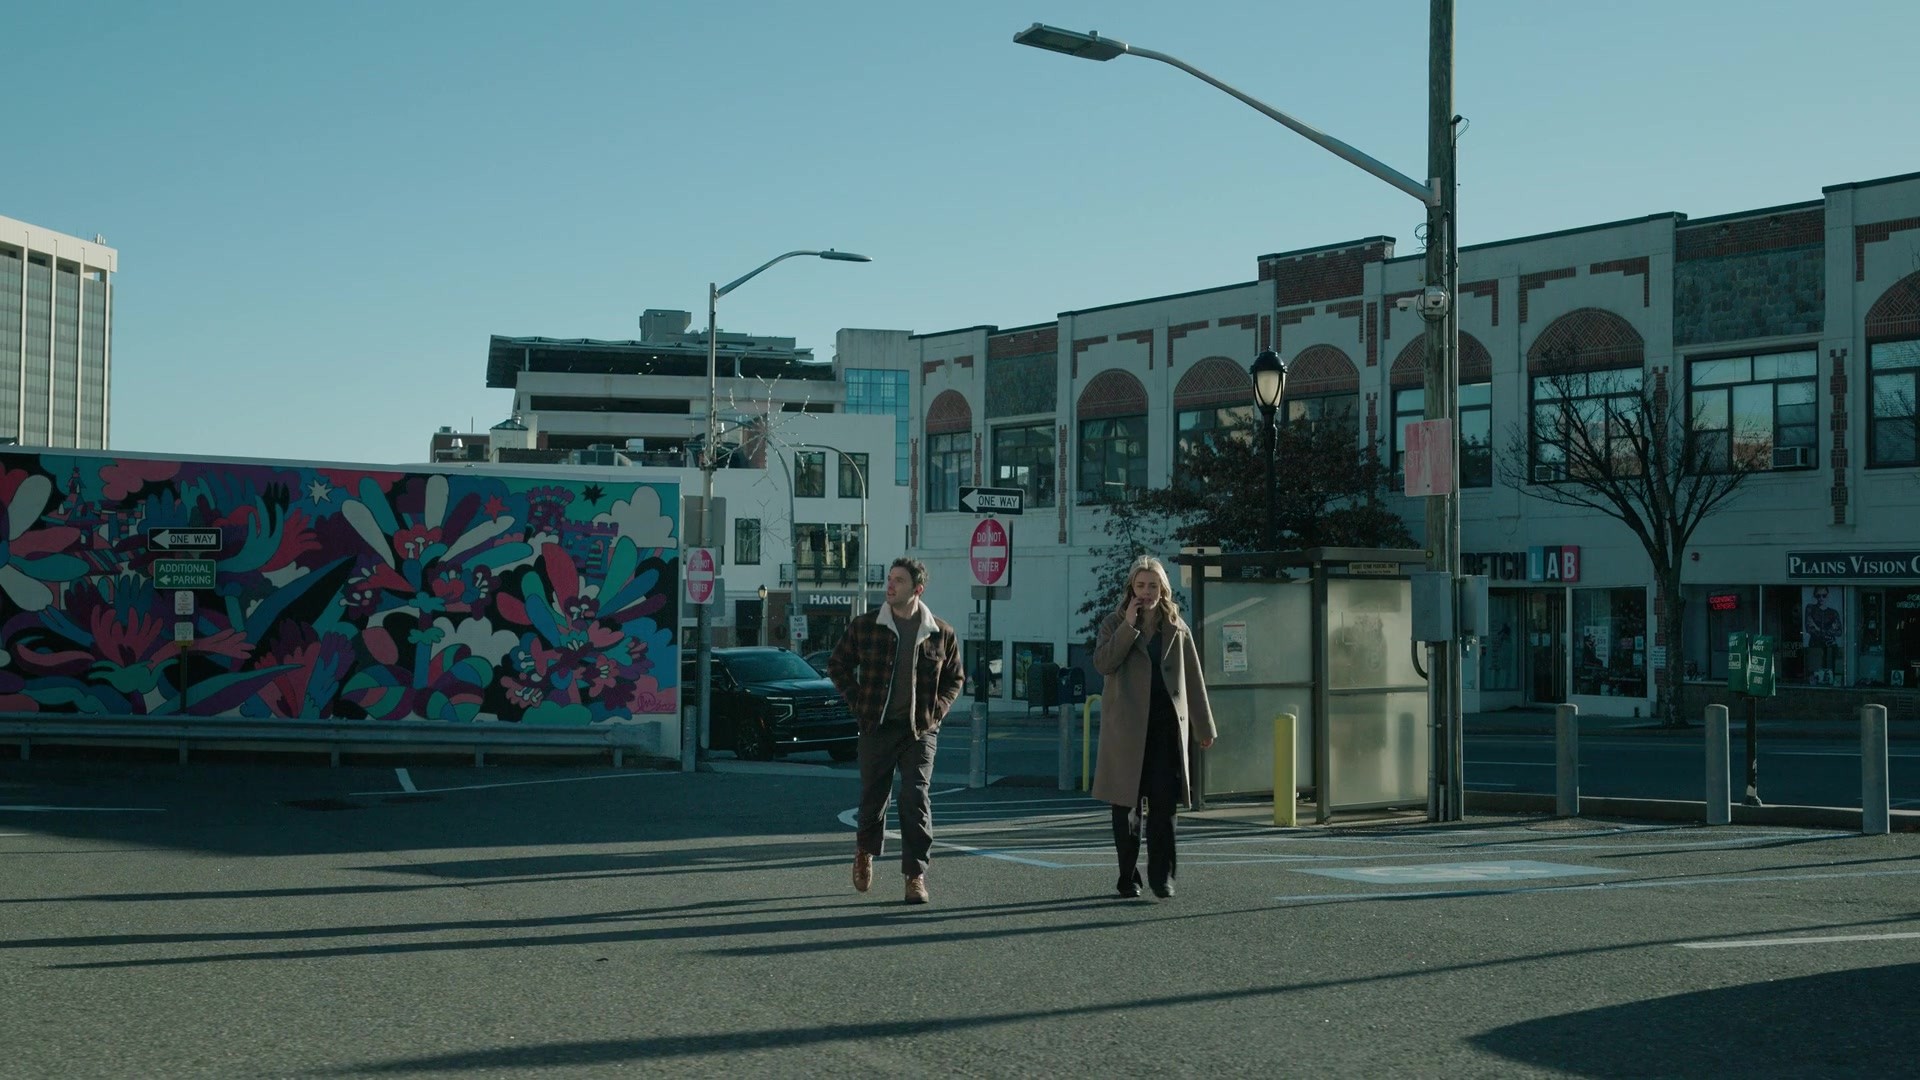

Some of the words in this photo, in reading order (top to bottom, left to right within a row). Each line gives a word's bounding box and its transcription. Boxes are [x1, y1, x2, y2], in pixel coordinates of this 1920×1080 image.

[978, 495, 996, 506] ONE
[999, 497, 1018, 507] WAY
[170, 534, 190, 544] ONE
[193, 534, 213, 544] WAY
[976, 531, 987, 542] DO
[989, 531, 1002, 542] NOT
[158, 563, 211, 573] ADDITIONAL
[977, 561, 1000, 572] ENTER
[1531, 551, 1576, 579] LAB
[1789, 556, 1846, 574] PLAINS
[1848, 555, 1907, 574] VISION
[172, 575, 212, 585] PARKING
[692, 583, 709, 593] ENTER
[809, 594, 851, 605] HAIKU
